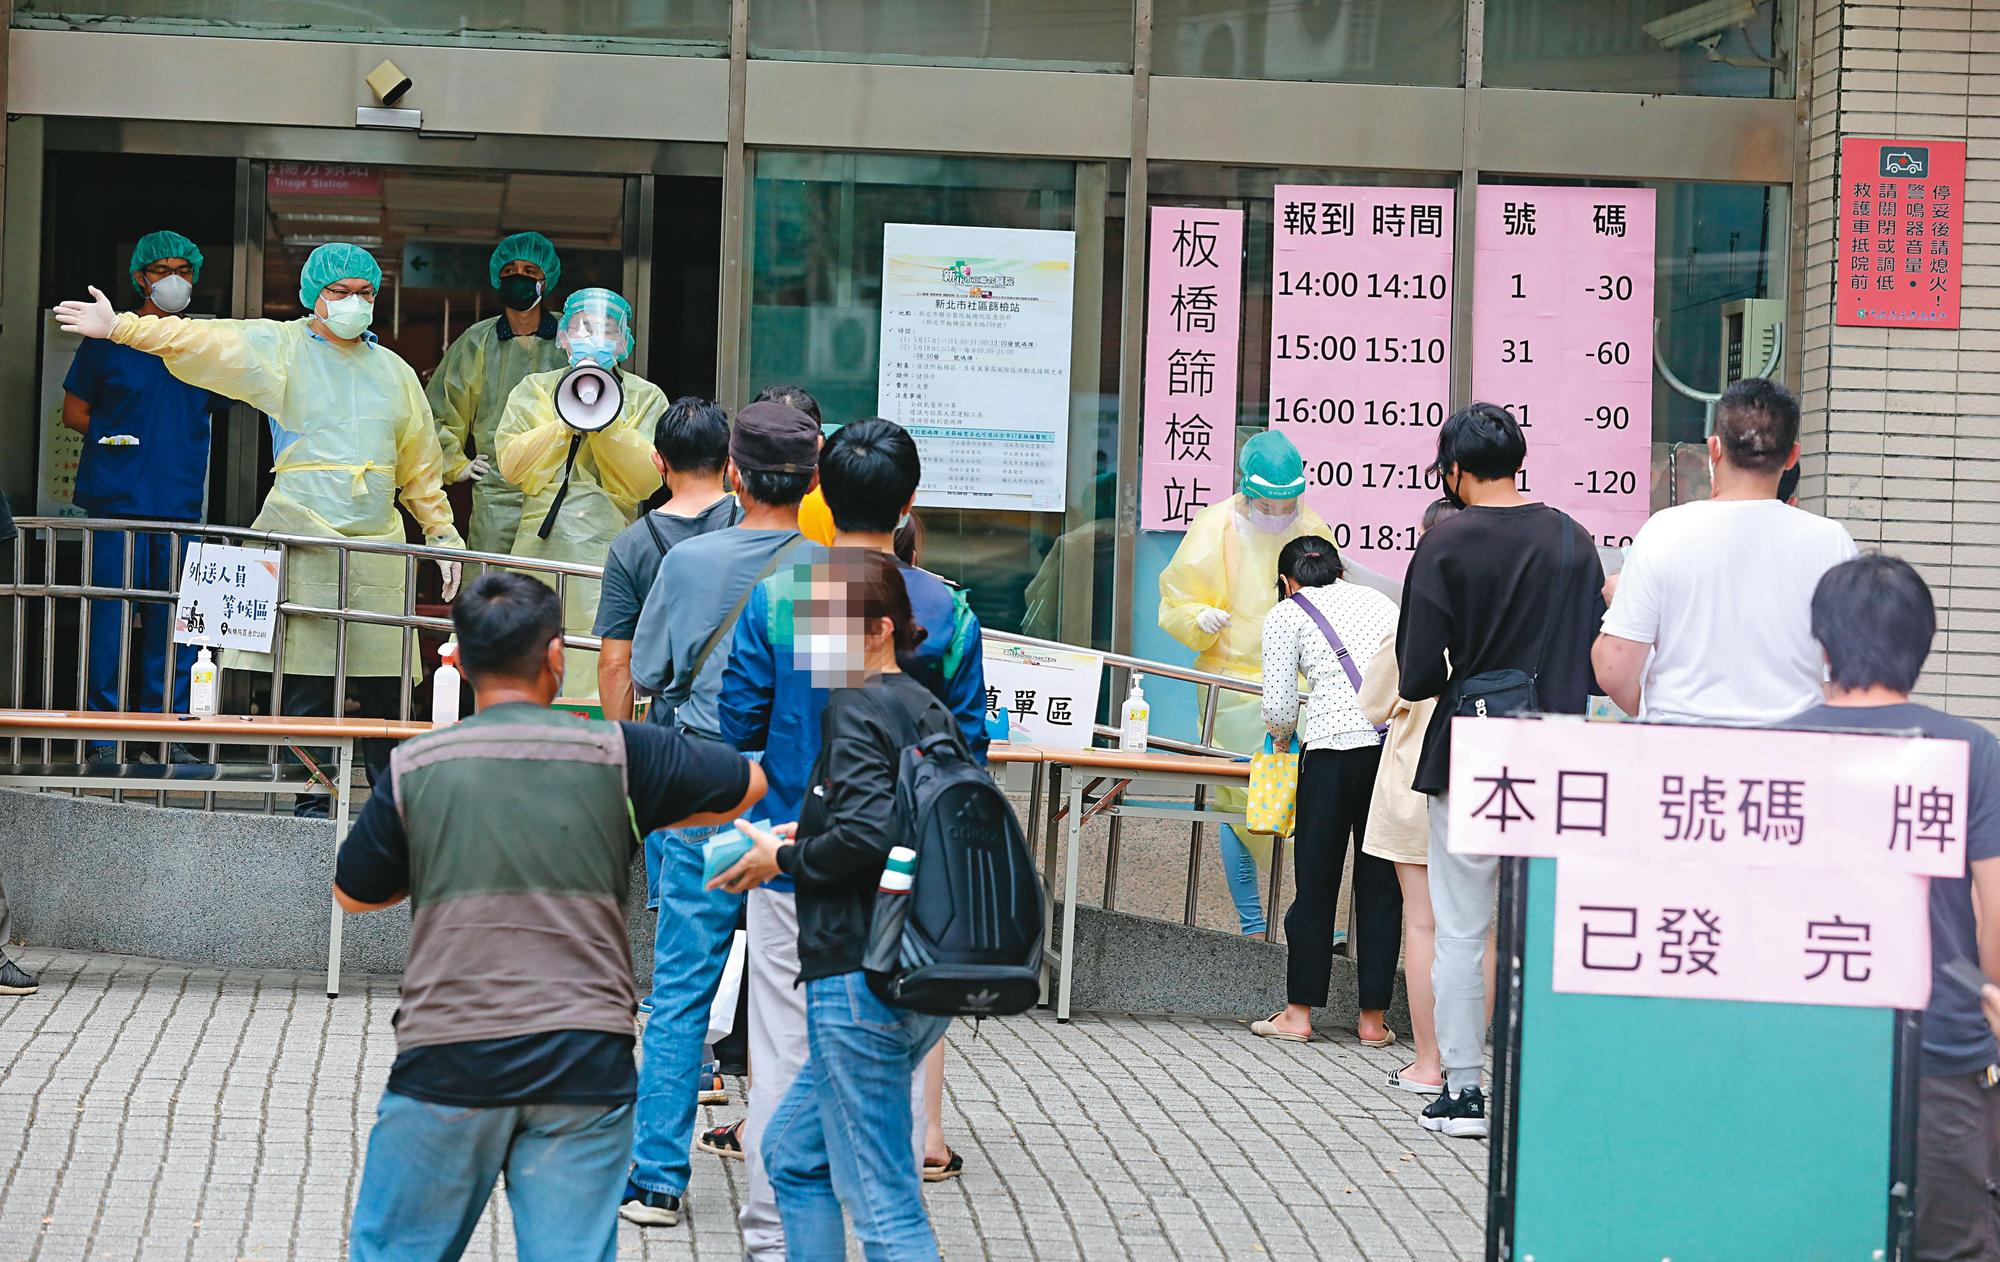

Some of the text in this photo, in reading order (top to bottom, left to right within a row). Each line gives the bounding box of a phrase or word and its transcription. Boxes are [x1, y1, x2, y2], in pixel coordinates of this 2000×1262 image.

[275, 178, 349, 189] Triage Station
[1283, 201, 1443, 239] 報到 時間
[1503, 202, 1627, 238] 號 碼
[1876, 183, 1897, 290] 請關閉或調低
[1278, 271, 1447, 300] 14:00 14:10
[1511, 273, 1633, 301] 1 -30
[935, 299, 1020, 313] 新北市社區篩檢站
[1276, 333, 1446, 364] 15:00 15:10
[1501, 339, 1631, 366] 31 -60
[1161, 218, 1221, 526] 板橋篩檢站
[1274, 397, 1444, 428] 16:00 16:10
[1584, 405, 1630, 430] -90
[1574, 470, 1637, 495] -120
[1359, 524, 1418, 551] 18:1
[189, 561, 247, 589] 外送人員
[222, 593, 269, 621] 等候區
[1470, 765, 1957, 854] 本日 號碼 牌
[1578, 904, 1873, 983] 已發 完
